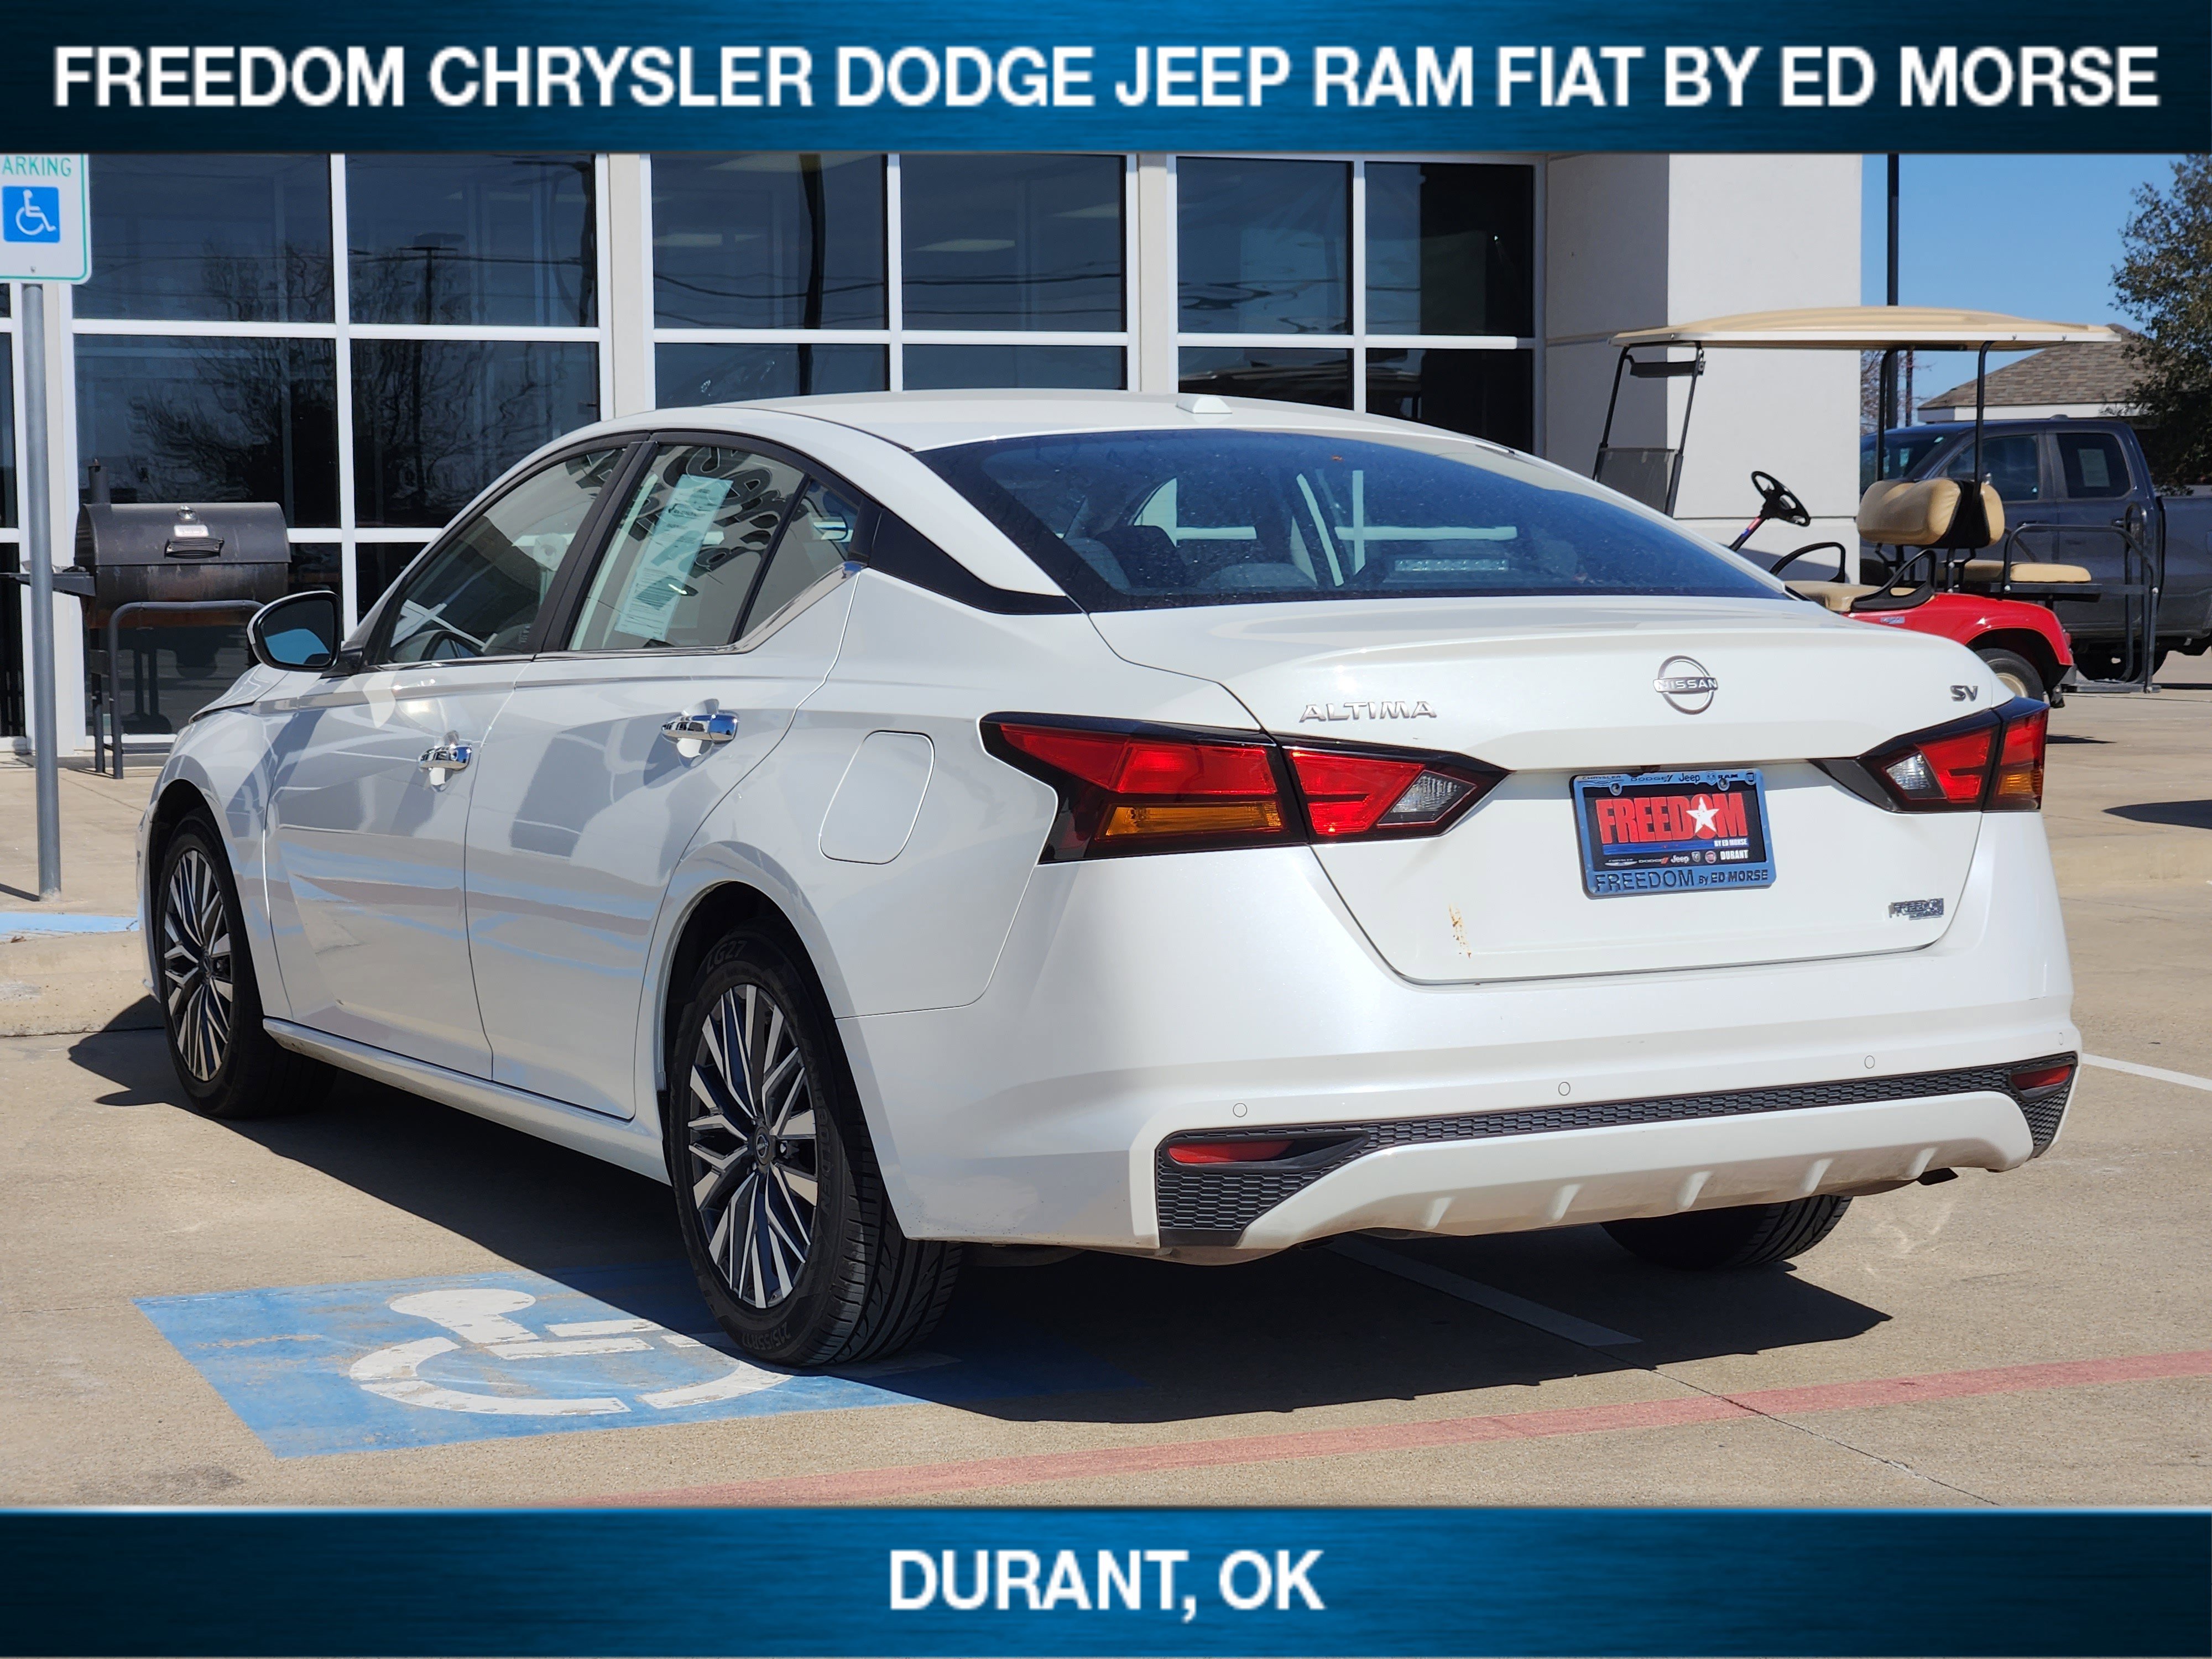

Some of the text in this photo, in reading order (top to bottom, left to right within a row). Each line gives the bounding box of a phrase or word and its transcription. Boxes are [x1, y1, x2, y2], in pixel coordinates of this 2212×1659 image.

[2, 155, 72, 178] ARKING
[1658, 679, 1717, 690] NISSAN
[1950, 685, 1978, 702] SV
[1299, 701, 1437, 723] ALTIMA
[1678, 773, 1700, 783] Jeep
[1595, 792, 1749, 844] FREEDOM
[1671, 854, 1690, 864] Jeep
[1720, 850, 1749, 860] DURANT
[1595, 869, 1694, 892] FREEDOM
[1711, 872, 1725, 883] ED
[1728, 869, 1768, 882] MORSE
[706, 940, 748, 974] LG27
